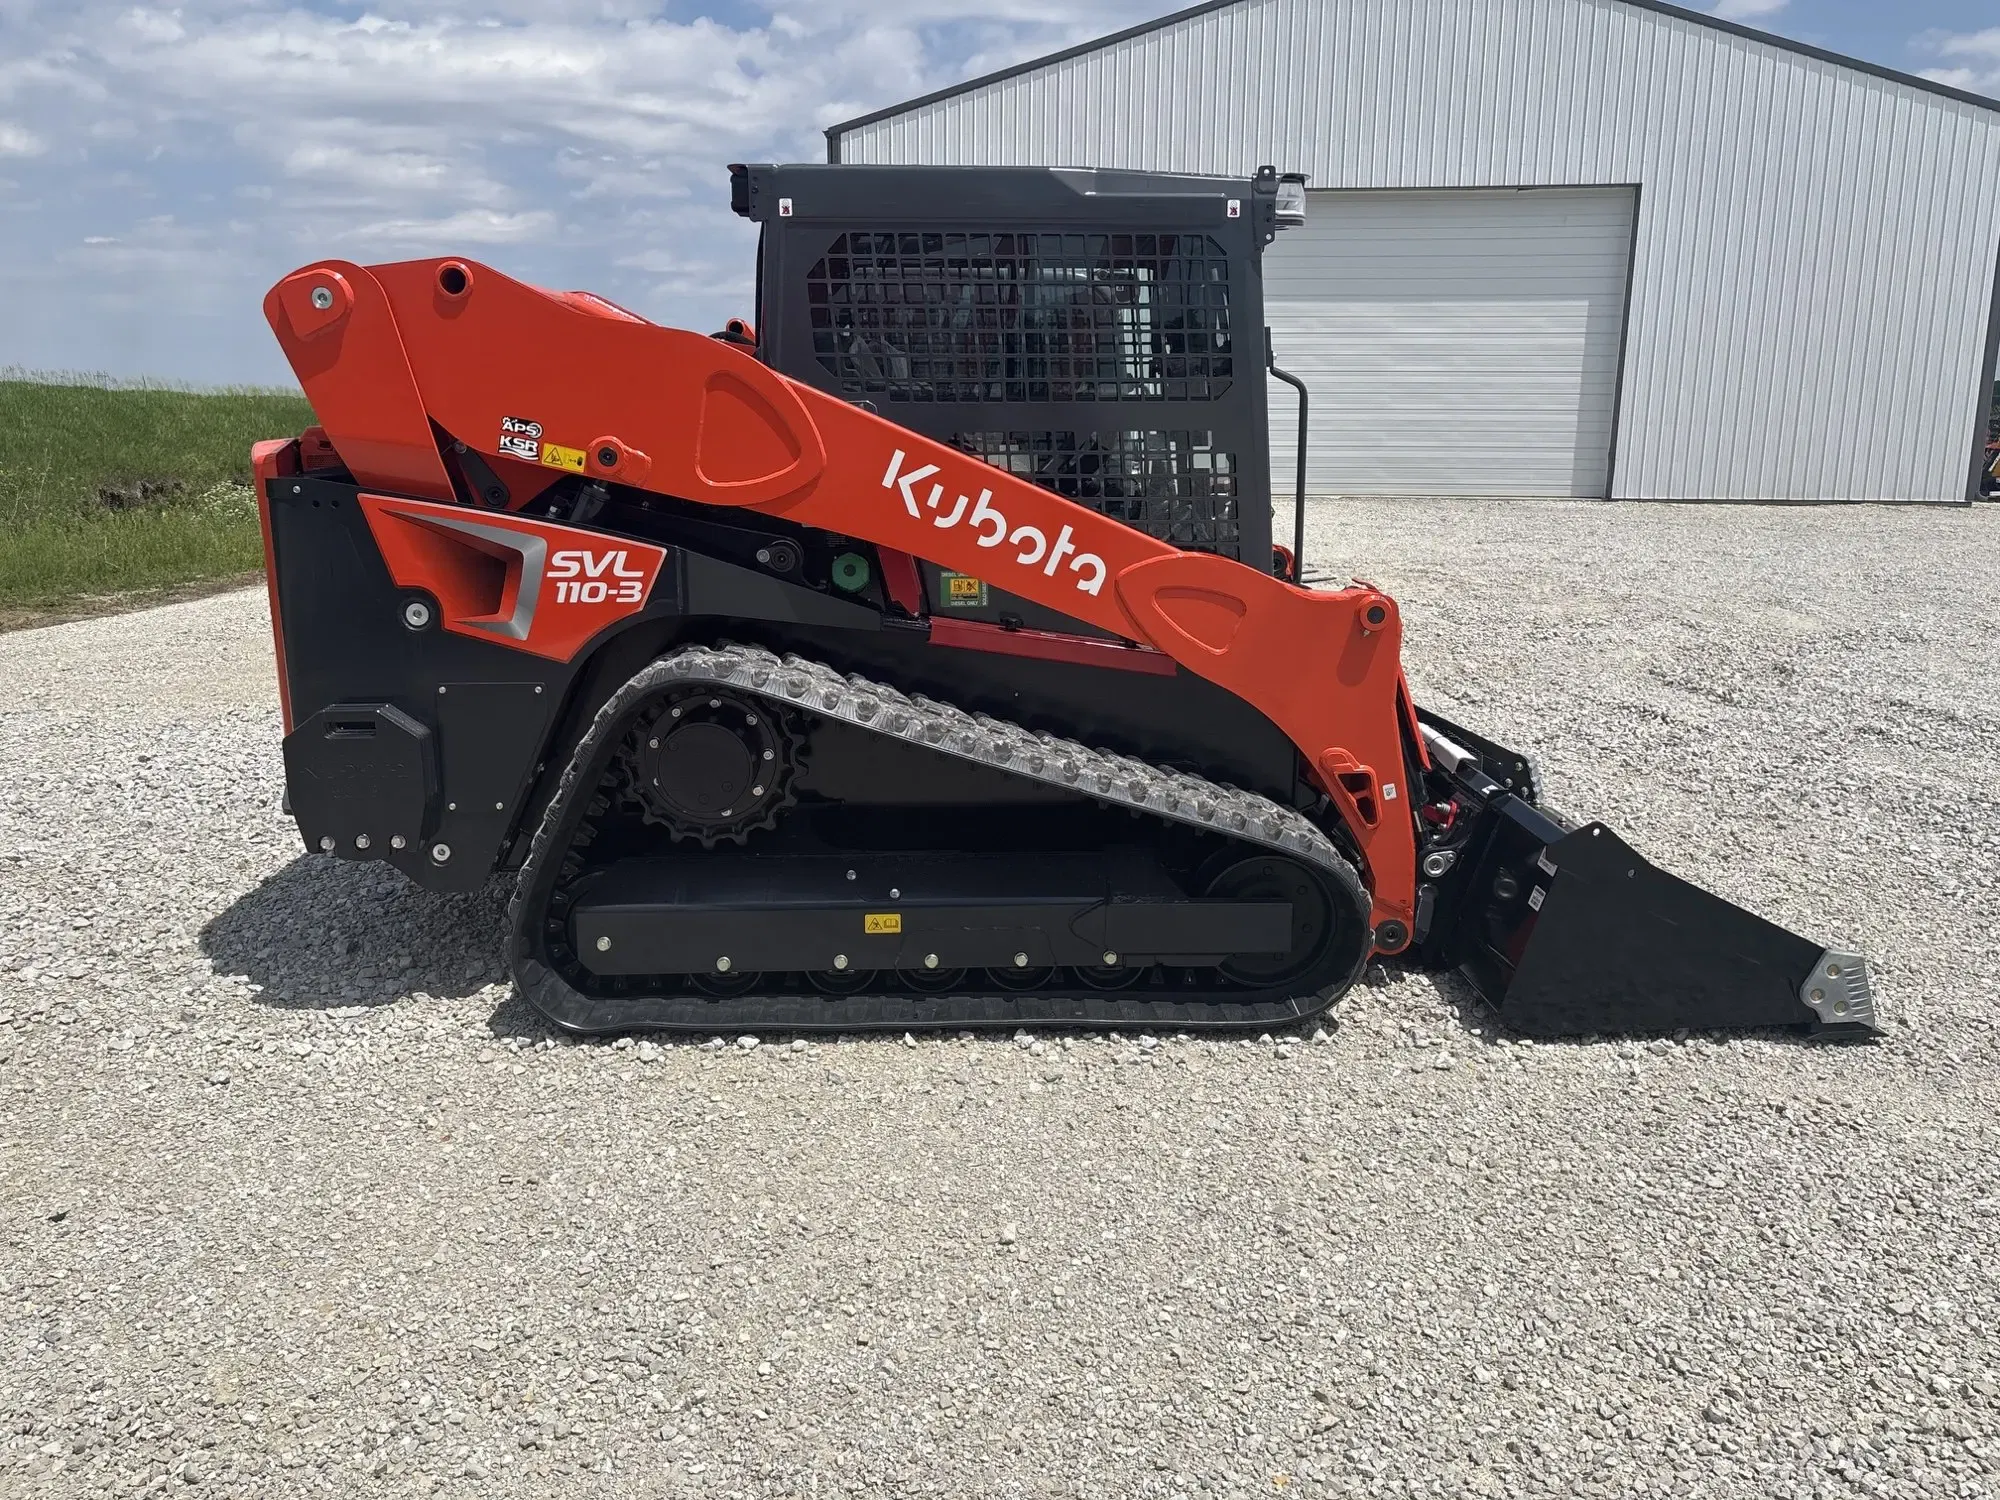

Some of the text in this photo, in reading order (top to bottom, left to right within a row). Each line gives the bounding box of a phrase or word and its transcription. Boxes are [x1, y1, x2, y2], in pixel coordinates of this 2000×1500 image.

[502, 420, 540, 437] APS
[500, 435, 539, 452] KSR
[882, 449, 1107, 597] Kubota
[547, 551, 645, 578] SVL
[556, 581, 643, 604] 110-3
